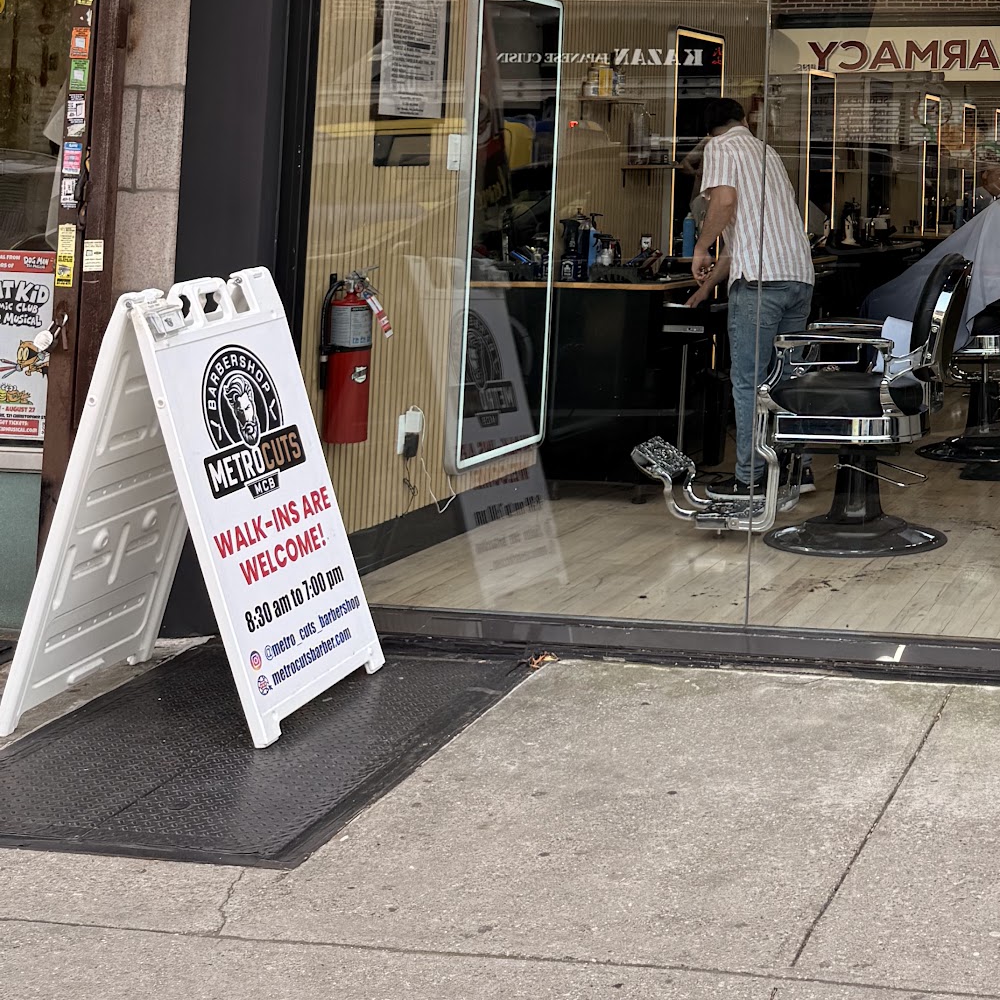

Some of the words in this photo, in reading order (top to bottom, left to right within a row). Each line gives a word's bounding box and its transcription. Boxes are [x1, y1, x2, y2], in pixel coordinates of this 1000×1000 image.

[16, 303, 38, 314] CLUB
[208, 354, 271, 411] BARBERSHOP
[254, 477, 276, 495] MCB
[213, 500, 300, 560] WALK-INS
[301, 486, 332, 519] ARE
[239, 523, 327, 586] WELCOME!
[244, 605, 273, 633] 8:30
[272, 598, 293, 619] am
[291, 587, 304, 607] to
[302, 571, 327, 601] 7:00
[325, 565, 345, 590] pm
[264, 594, 361, 661] @metro_cuts_barbershop
[271, 626, 352, 687] metrocutsbarber.com
